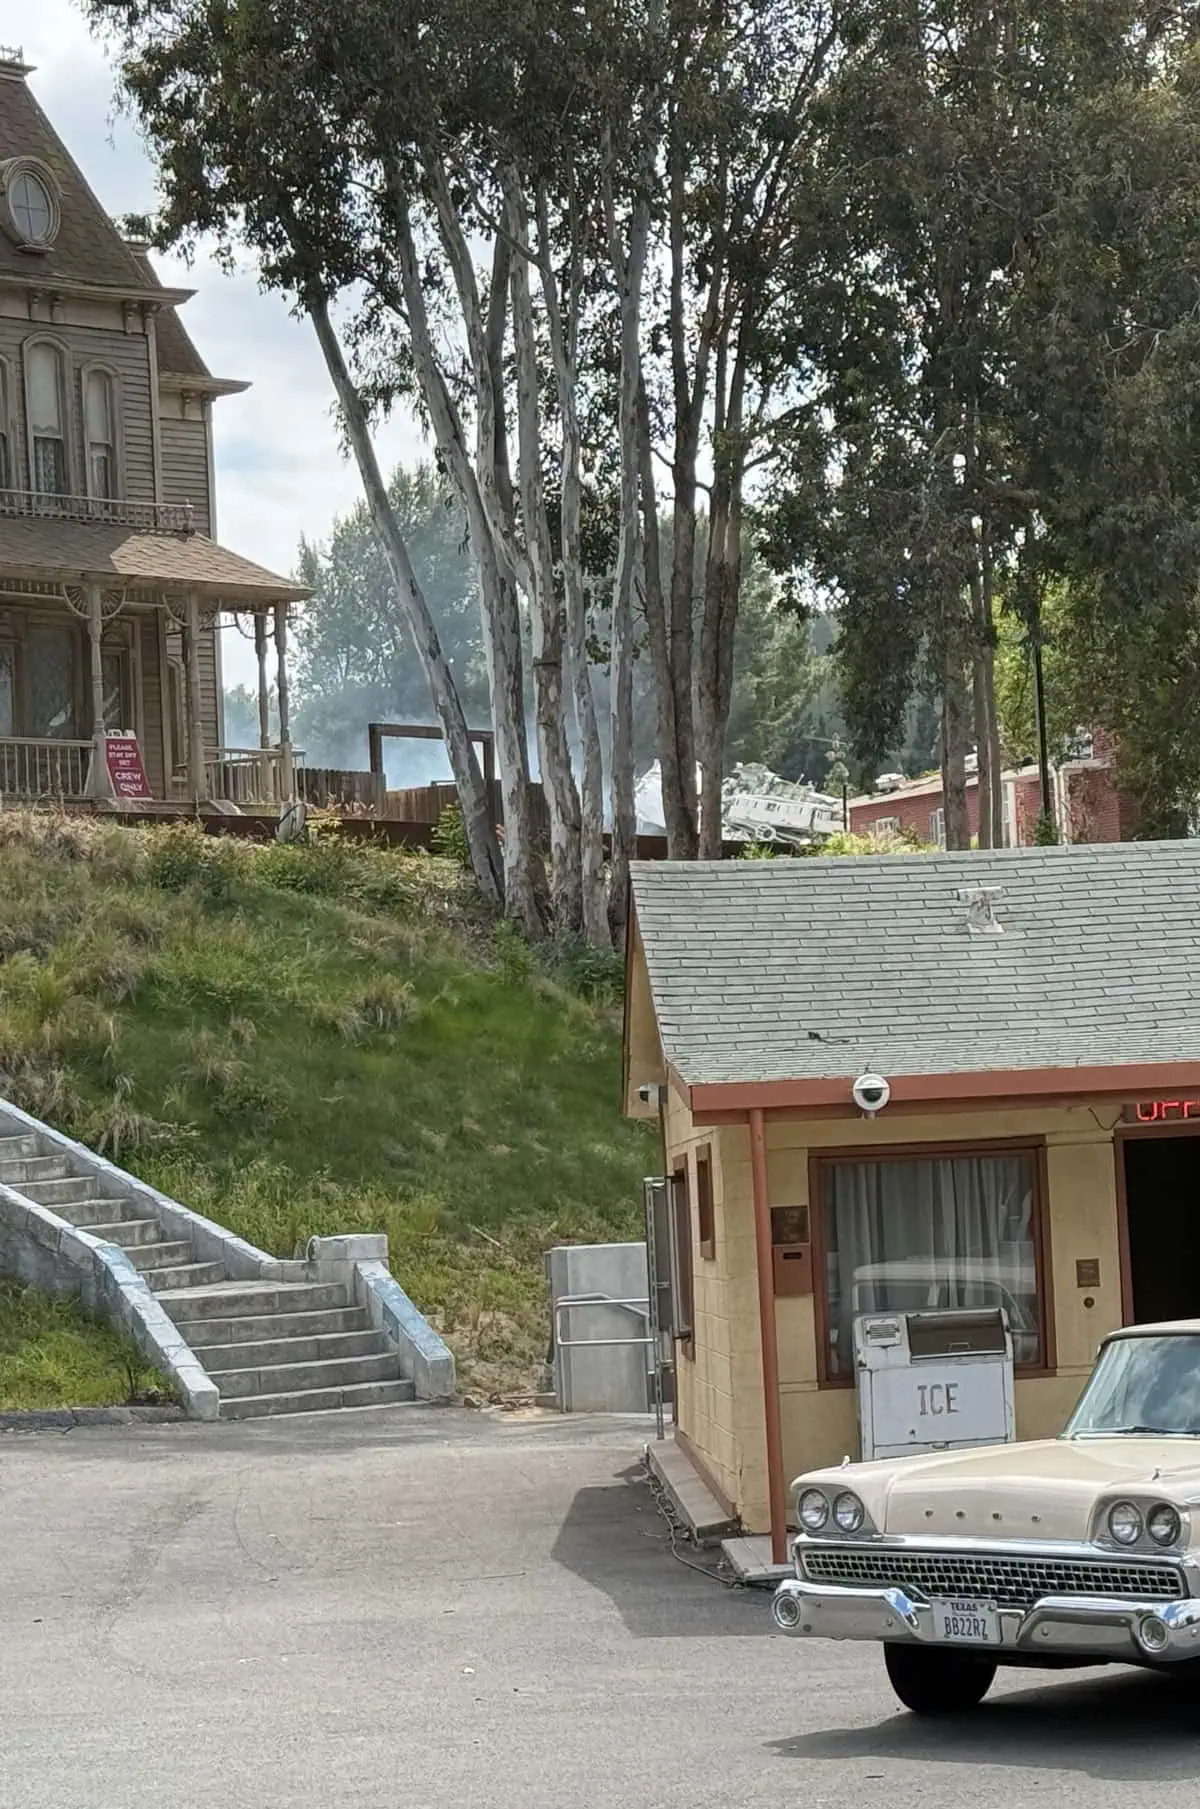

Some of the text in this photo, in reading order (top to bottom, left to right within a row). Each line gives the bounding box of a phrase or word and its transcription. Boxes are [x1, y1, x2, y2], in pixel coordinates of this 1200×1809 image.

[115, 772, 142, 781] CREW
[120, 783, 143, 793] ONLY
[917, 1383, 960, 1416] ICE
[951, 1602, 978, 1611] TEXAS
